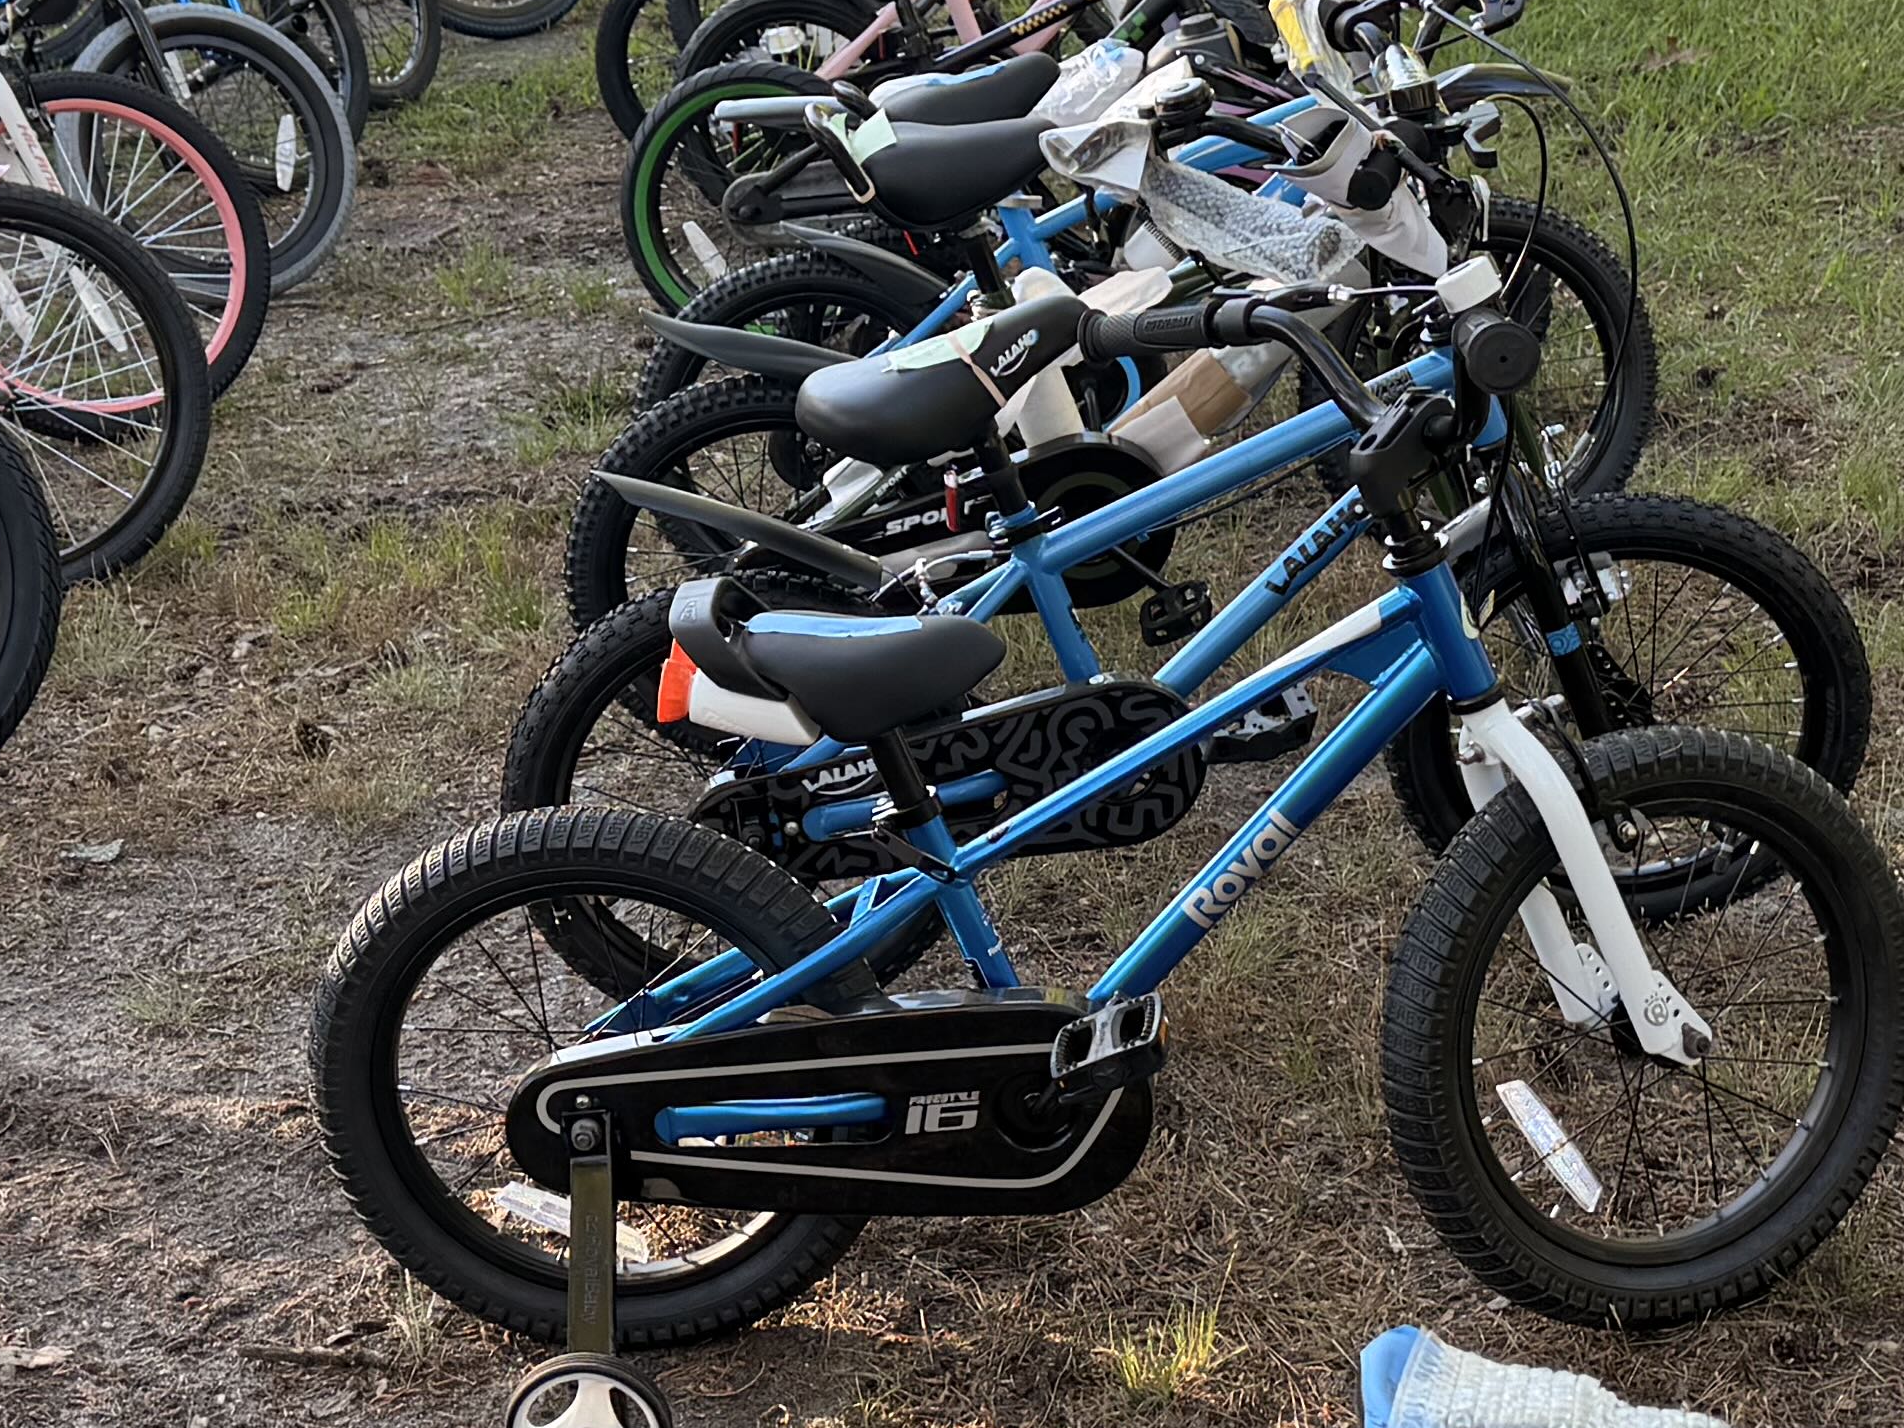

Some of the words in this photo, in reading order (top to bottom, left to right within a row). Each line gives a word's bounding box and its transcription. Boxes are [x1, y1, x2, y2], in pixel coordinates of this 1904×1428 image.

[885, 494, 993, 536] SPOT
[801, 758, 878, 793] LALAH
[1182, 808, 1300, 928] Royal
[905, 1099, 980, 1134] 16
